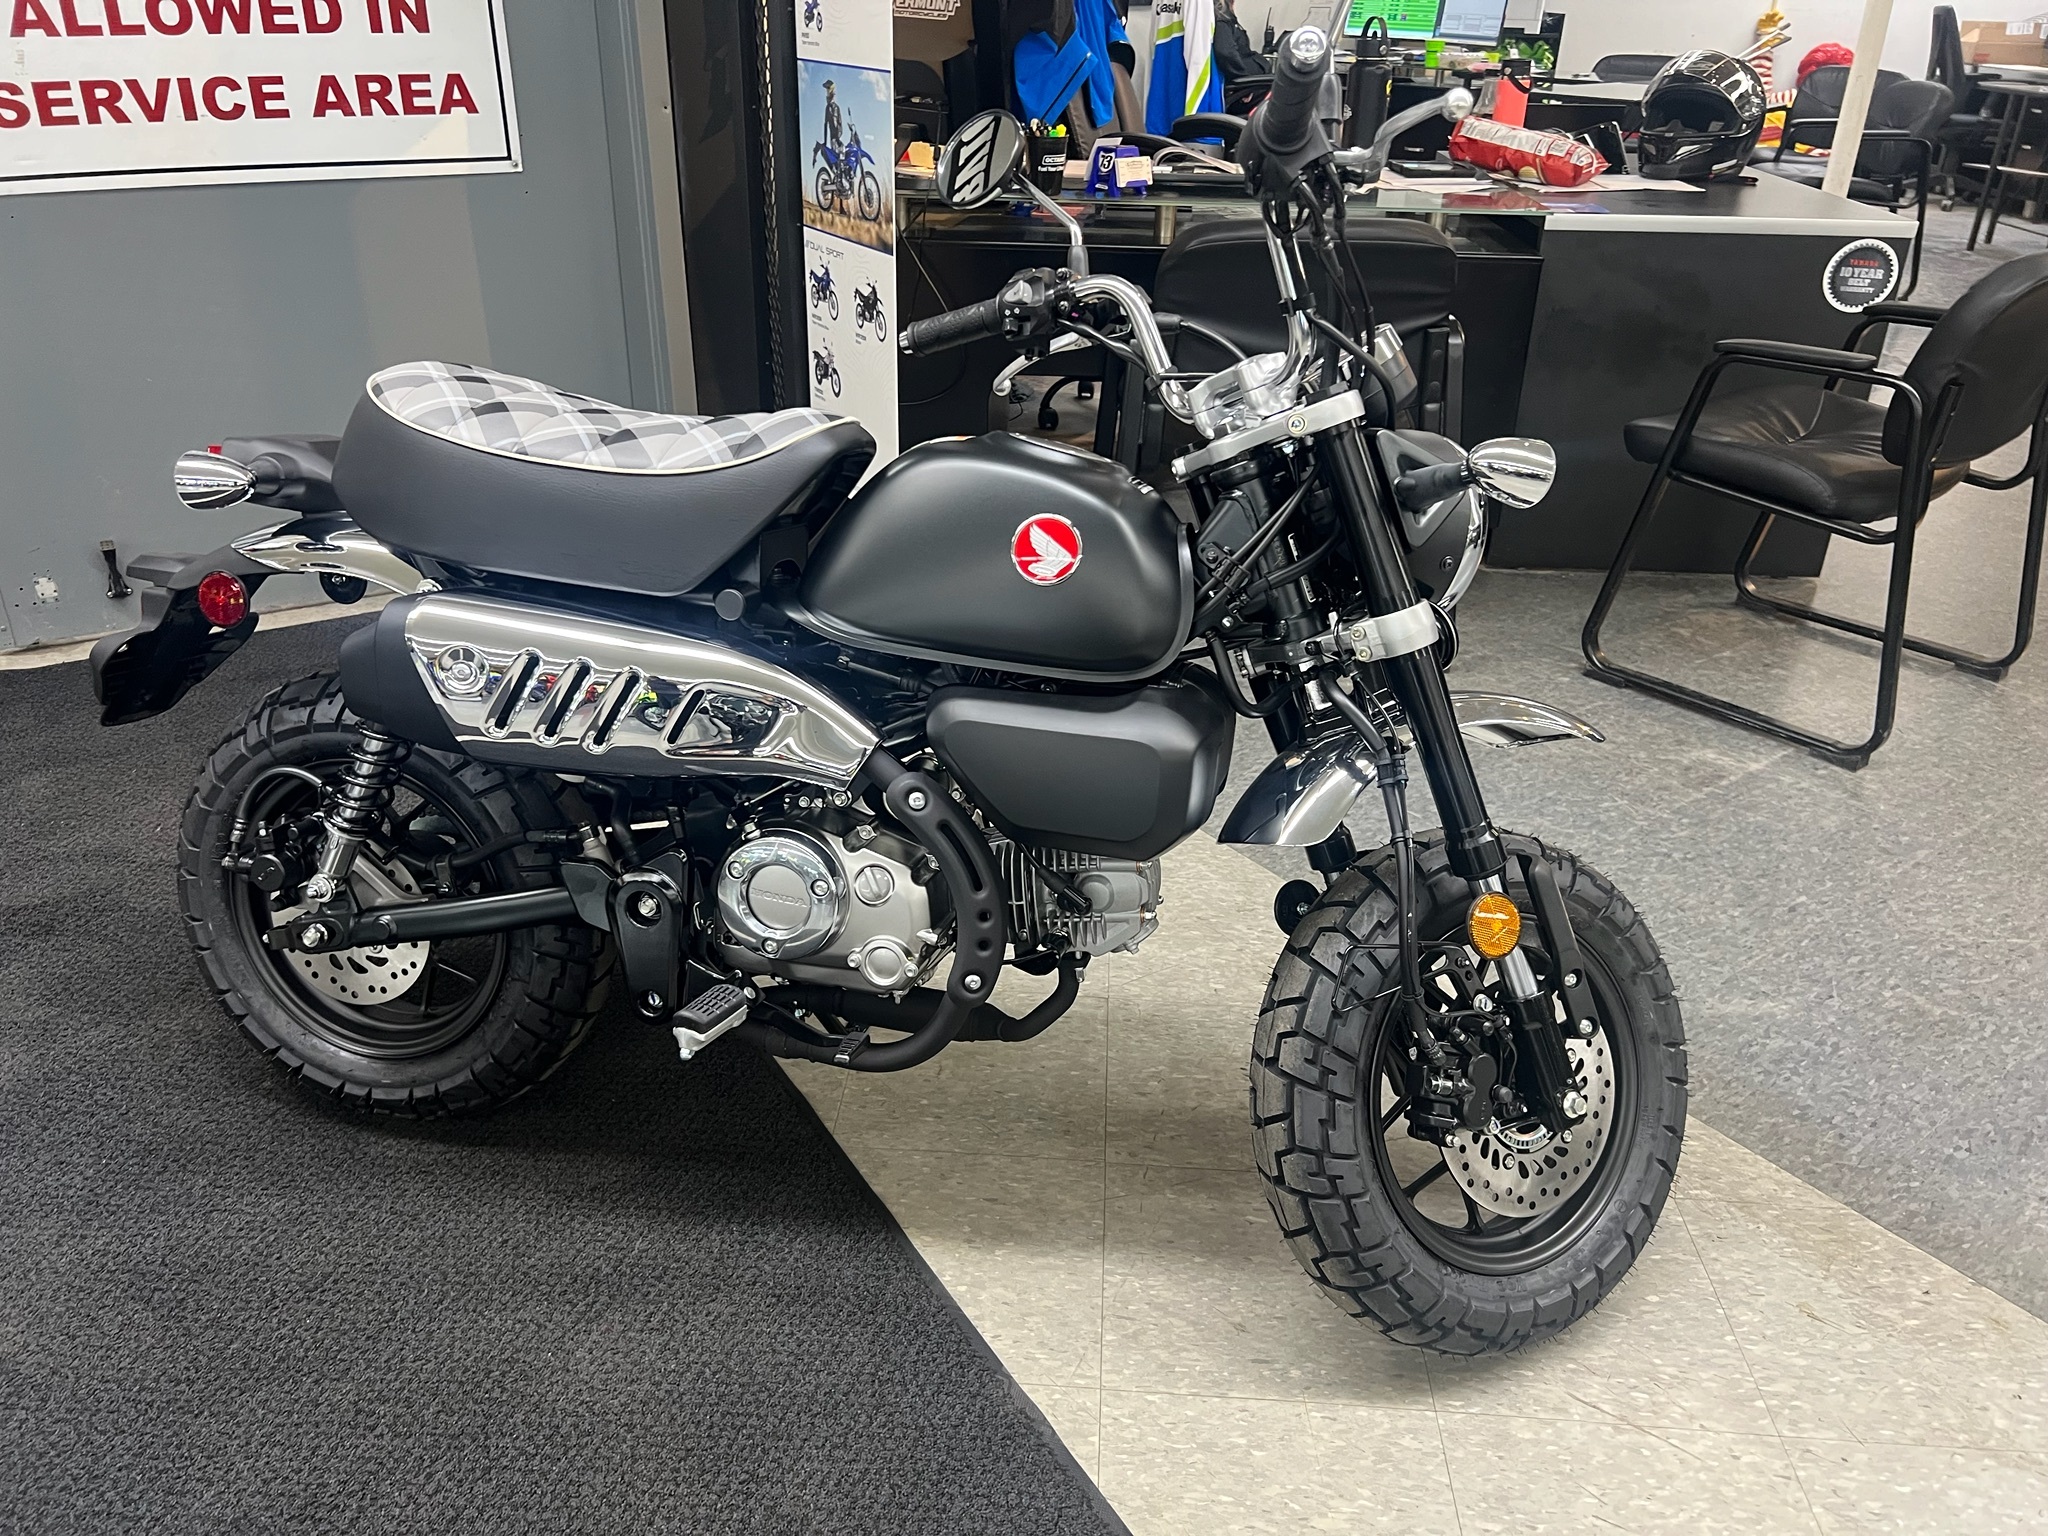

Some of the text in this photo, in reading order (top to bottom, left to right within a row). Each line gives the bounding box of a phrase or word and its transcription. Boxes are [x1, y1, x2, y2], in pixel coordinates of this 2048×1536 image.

[893, 0, 956, 11] ERMONT
[10, 0, 430, 37] ALLOWED IN
[0, 73, 480, 128] SERVICE AREA
[809, 241, 844, 260] DUAL SPORT
[1840, 267, 1885, 279] 10 YEAR
[751, 887, 808, 908] HONDA
